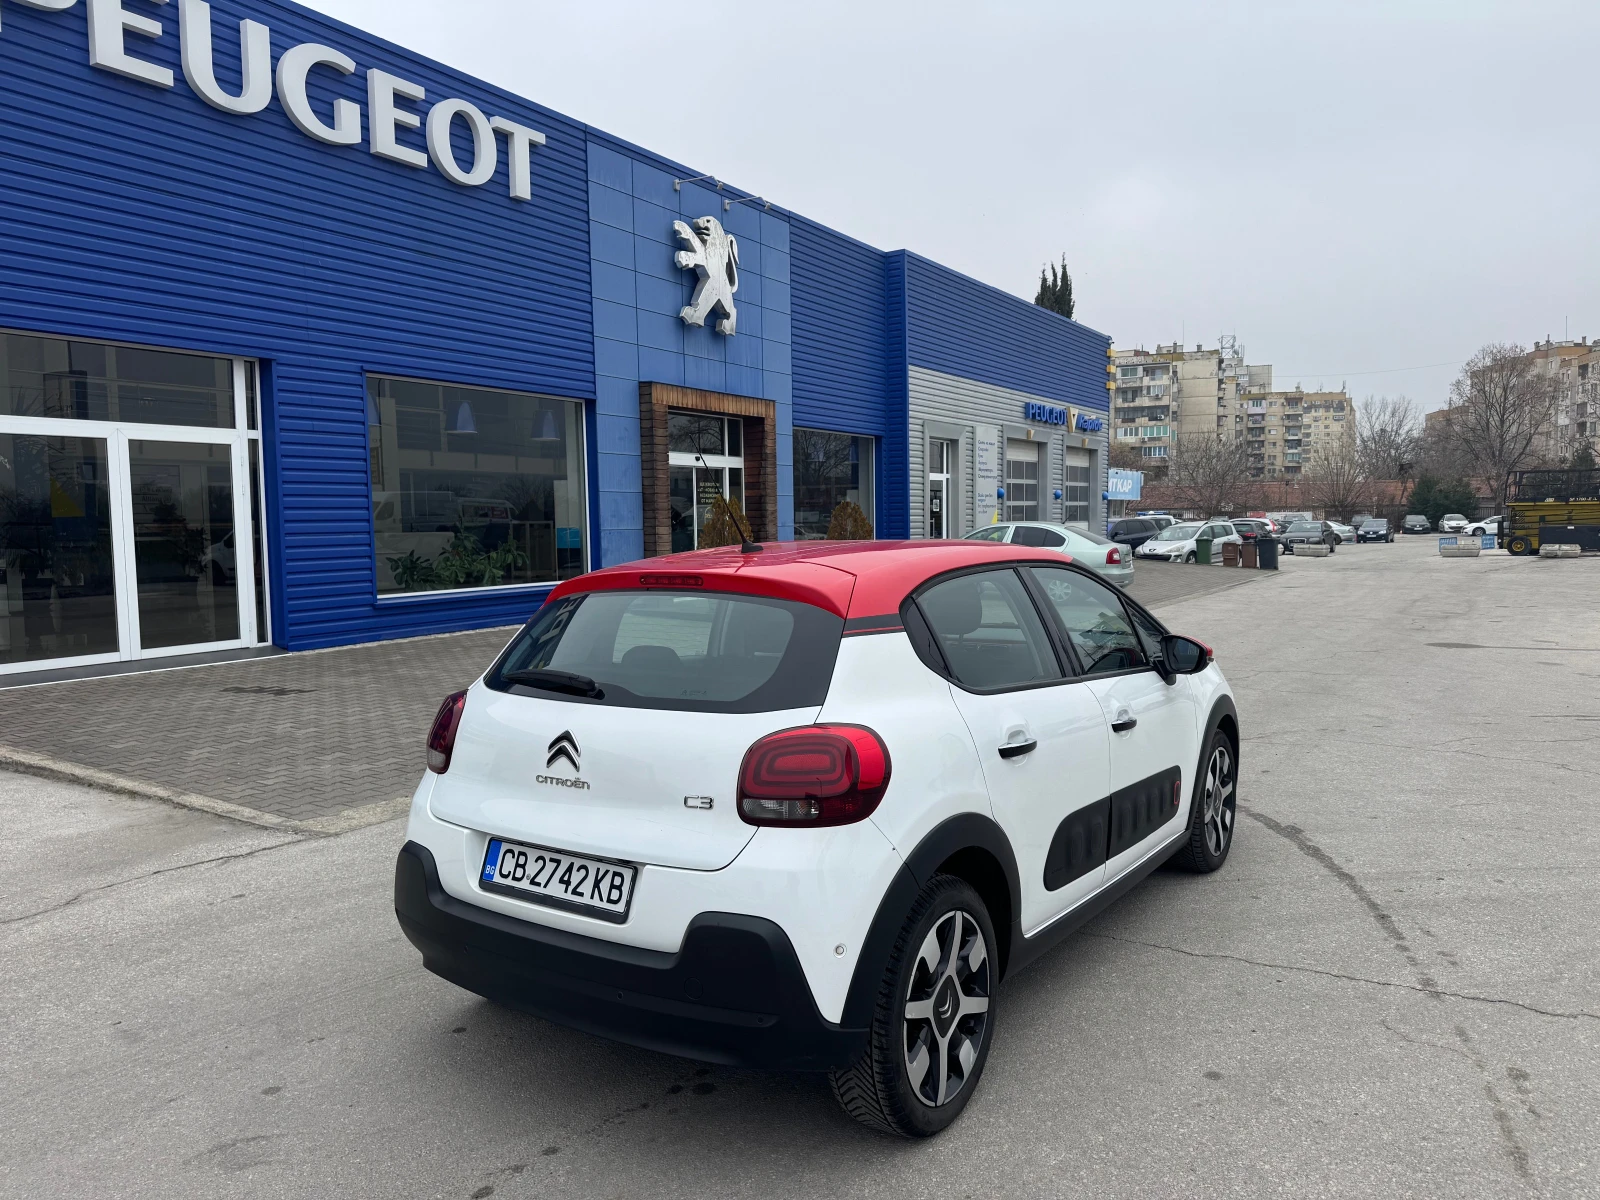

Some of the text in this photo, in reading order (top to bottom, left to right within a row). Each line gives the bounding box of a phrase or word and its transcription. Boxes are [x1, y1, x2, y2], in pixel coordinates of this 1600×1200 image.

[0, 0, 546, 200] EUGEOT
[1027, 402, 1067, 425] PEUGEOT
[535, 774, 591, 790] CITROËN
[683, 794, 715, 810] C3
[484, 864, 496, 875] BG
